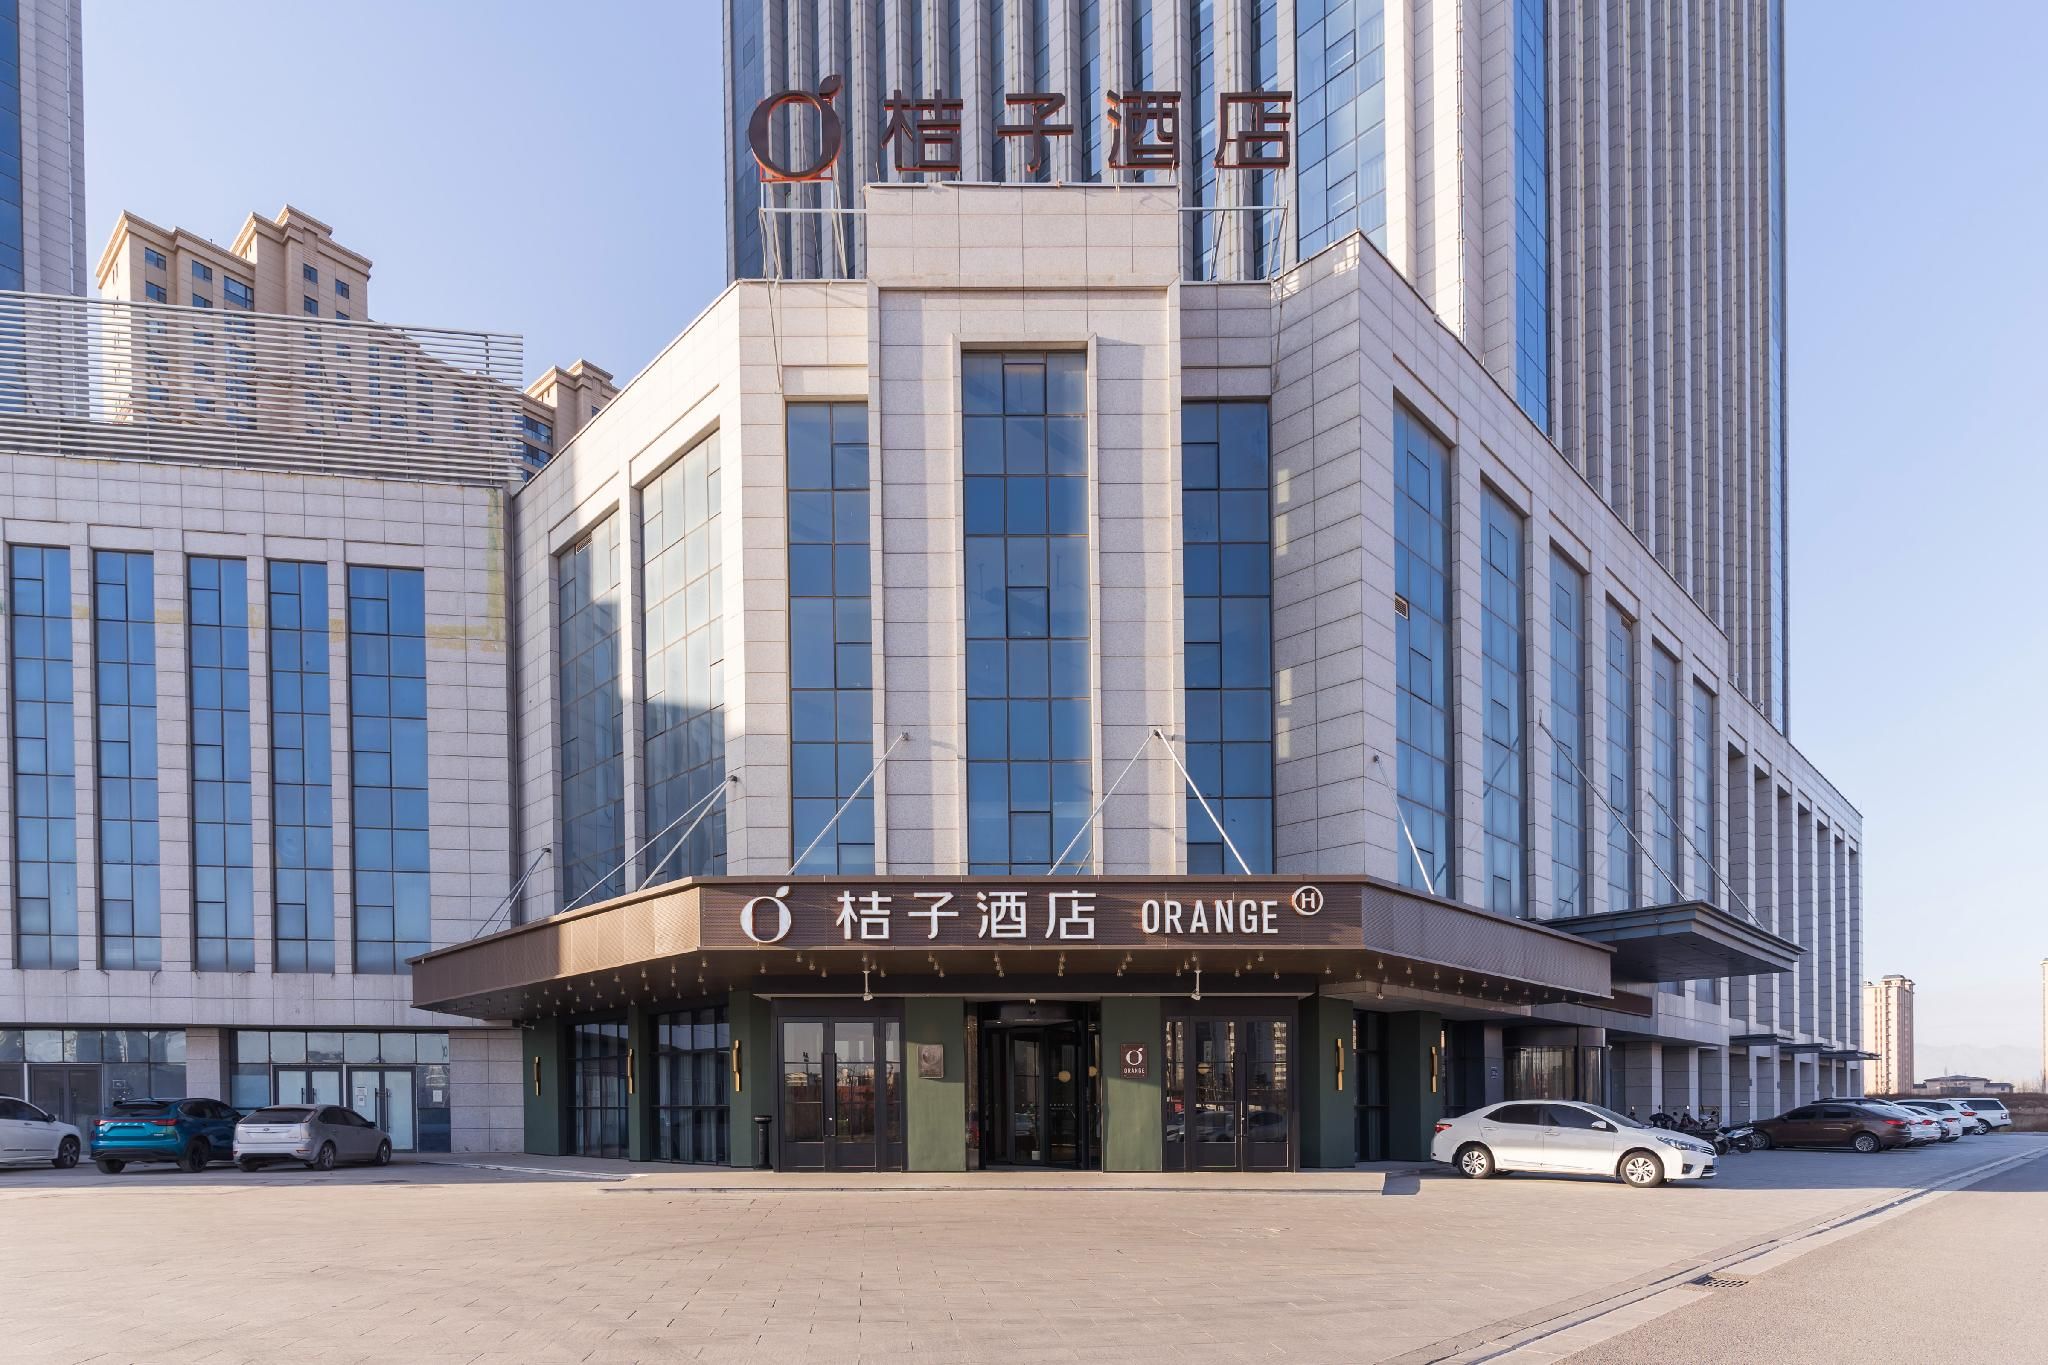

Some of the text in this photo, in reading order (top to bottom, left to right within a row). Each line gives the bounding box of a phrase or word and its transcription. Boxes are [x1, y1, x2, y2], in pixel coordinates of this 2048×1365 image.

[881, 88, 1293, 172] 桔子酒店
[836, 890, 1096, 939] 桔子酒店
[1142, 900, 1278, 934] ORANGE
